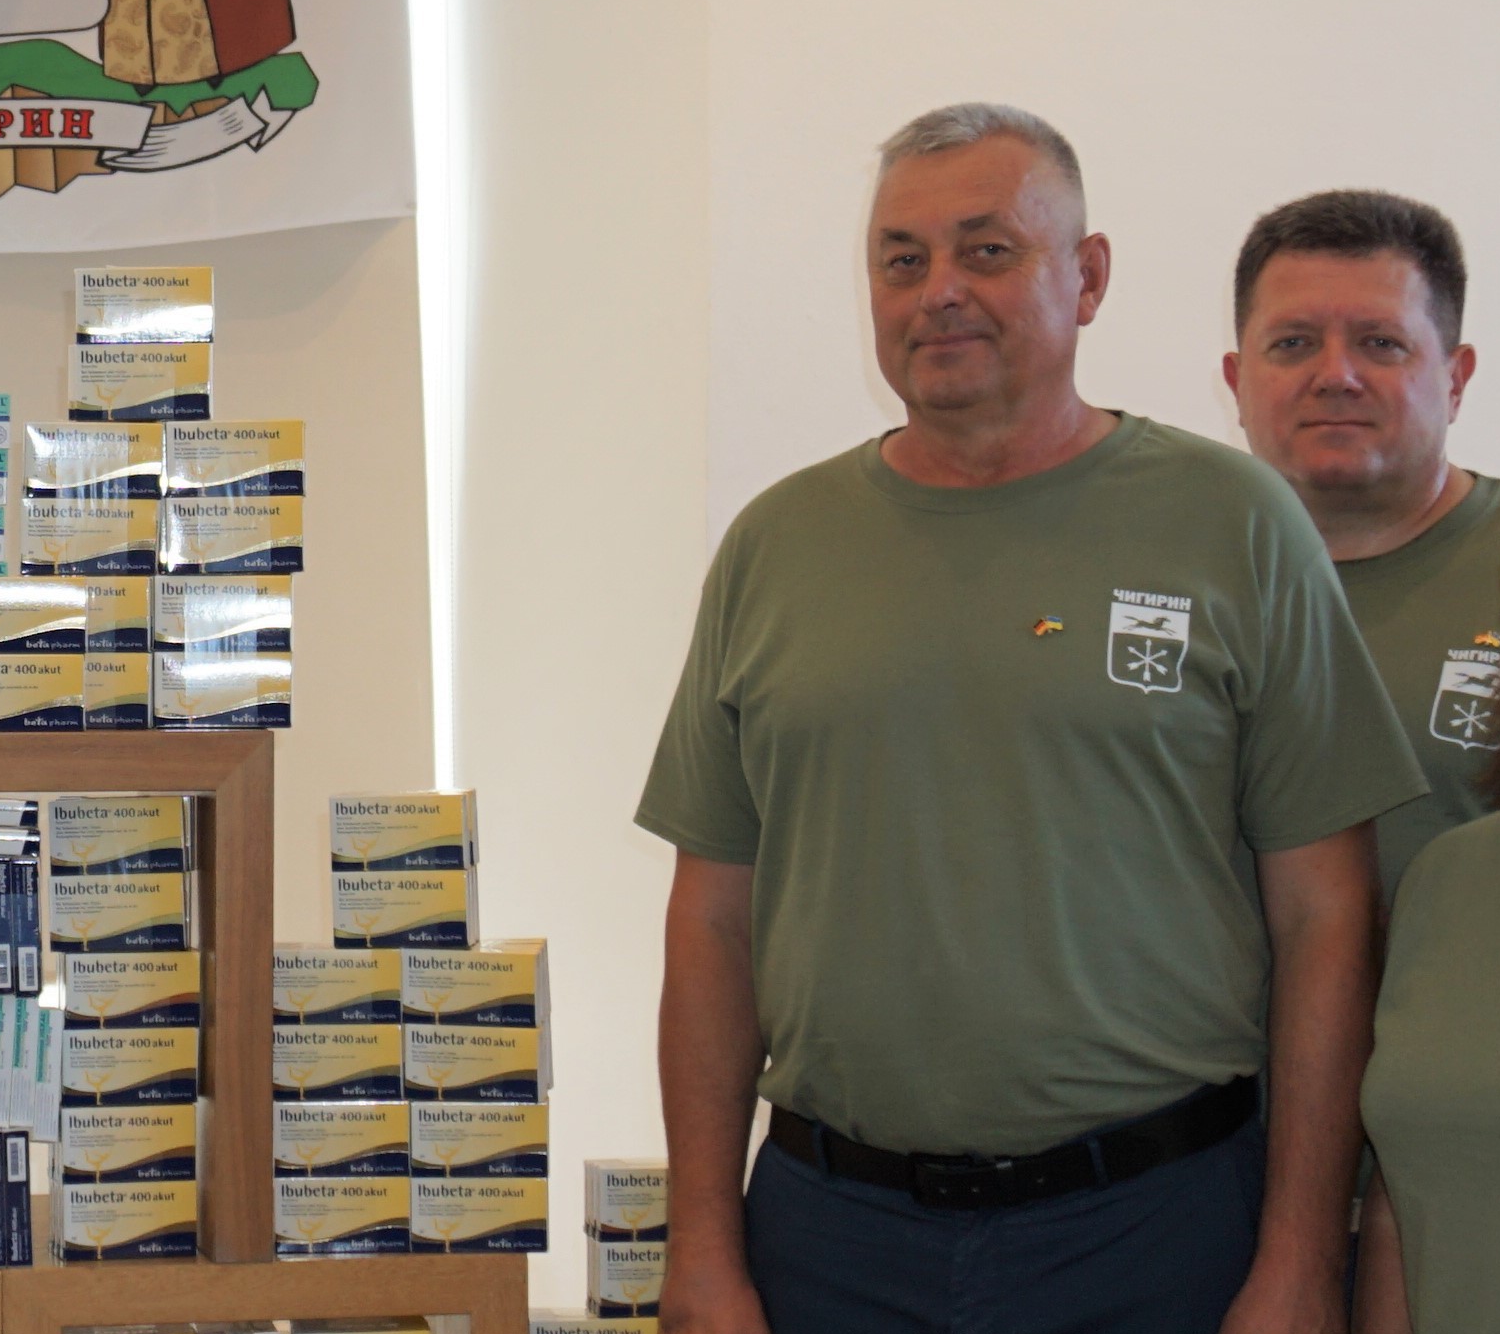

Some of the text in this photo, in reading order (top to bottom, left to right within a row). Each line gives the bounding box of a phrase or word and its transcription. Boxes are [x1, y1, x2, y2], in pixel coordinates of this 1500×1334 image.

[83, 274, 189, 287] Ibubeta 400 akut
[81, 350, 186, 363] Ibubeta 400 akut
[174, 427, 280, 440] Ibubeta 400 akut
[233, 505, 256, 516] 400
[1113, 588, 1192, 611] ЧИГИРИН
[55, 806, 159, 820] Ibubeta 400 akut
[336, 802, 440, 815] Ibubeta 400 akut
[55, 883, 160, 895] Ibubeta 400 akut
[338, 878, 443, 891] Ibubeta 400 akut
[73, 961, 178, 973] Ibubeta 400 akut
[409, 955, 513, 972] Ibubeta 400 akut
[70, 1036, 174, 1049] Ibubeta 400 akut
[479, 1112, 500, 1122] 400
